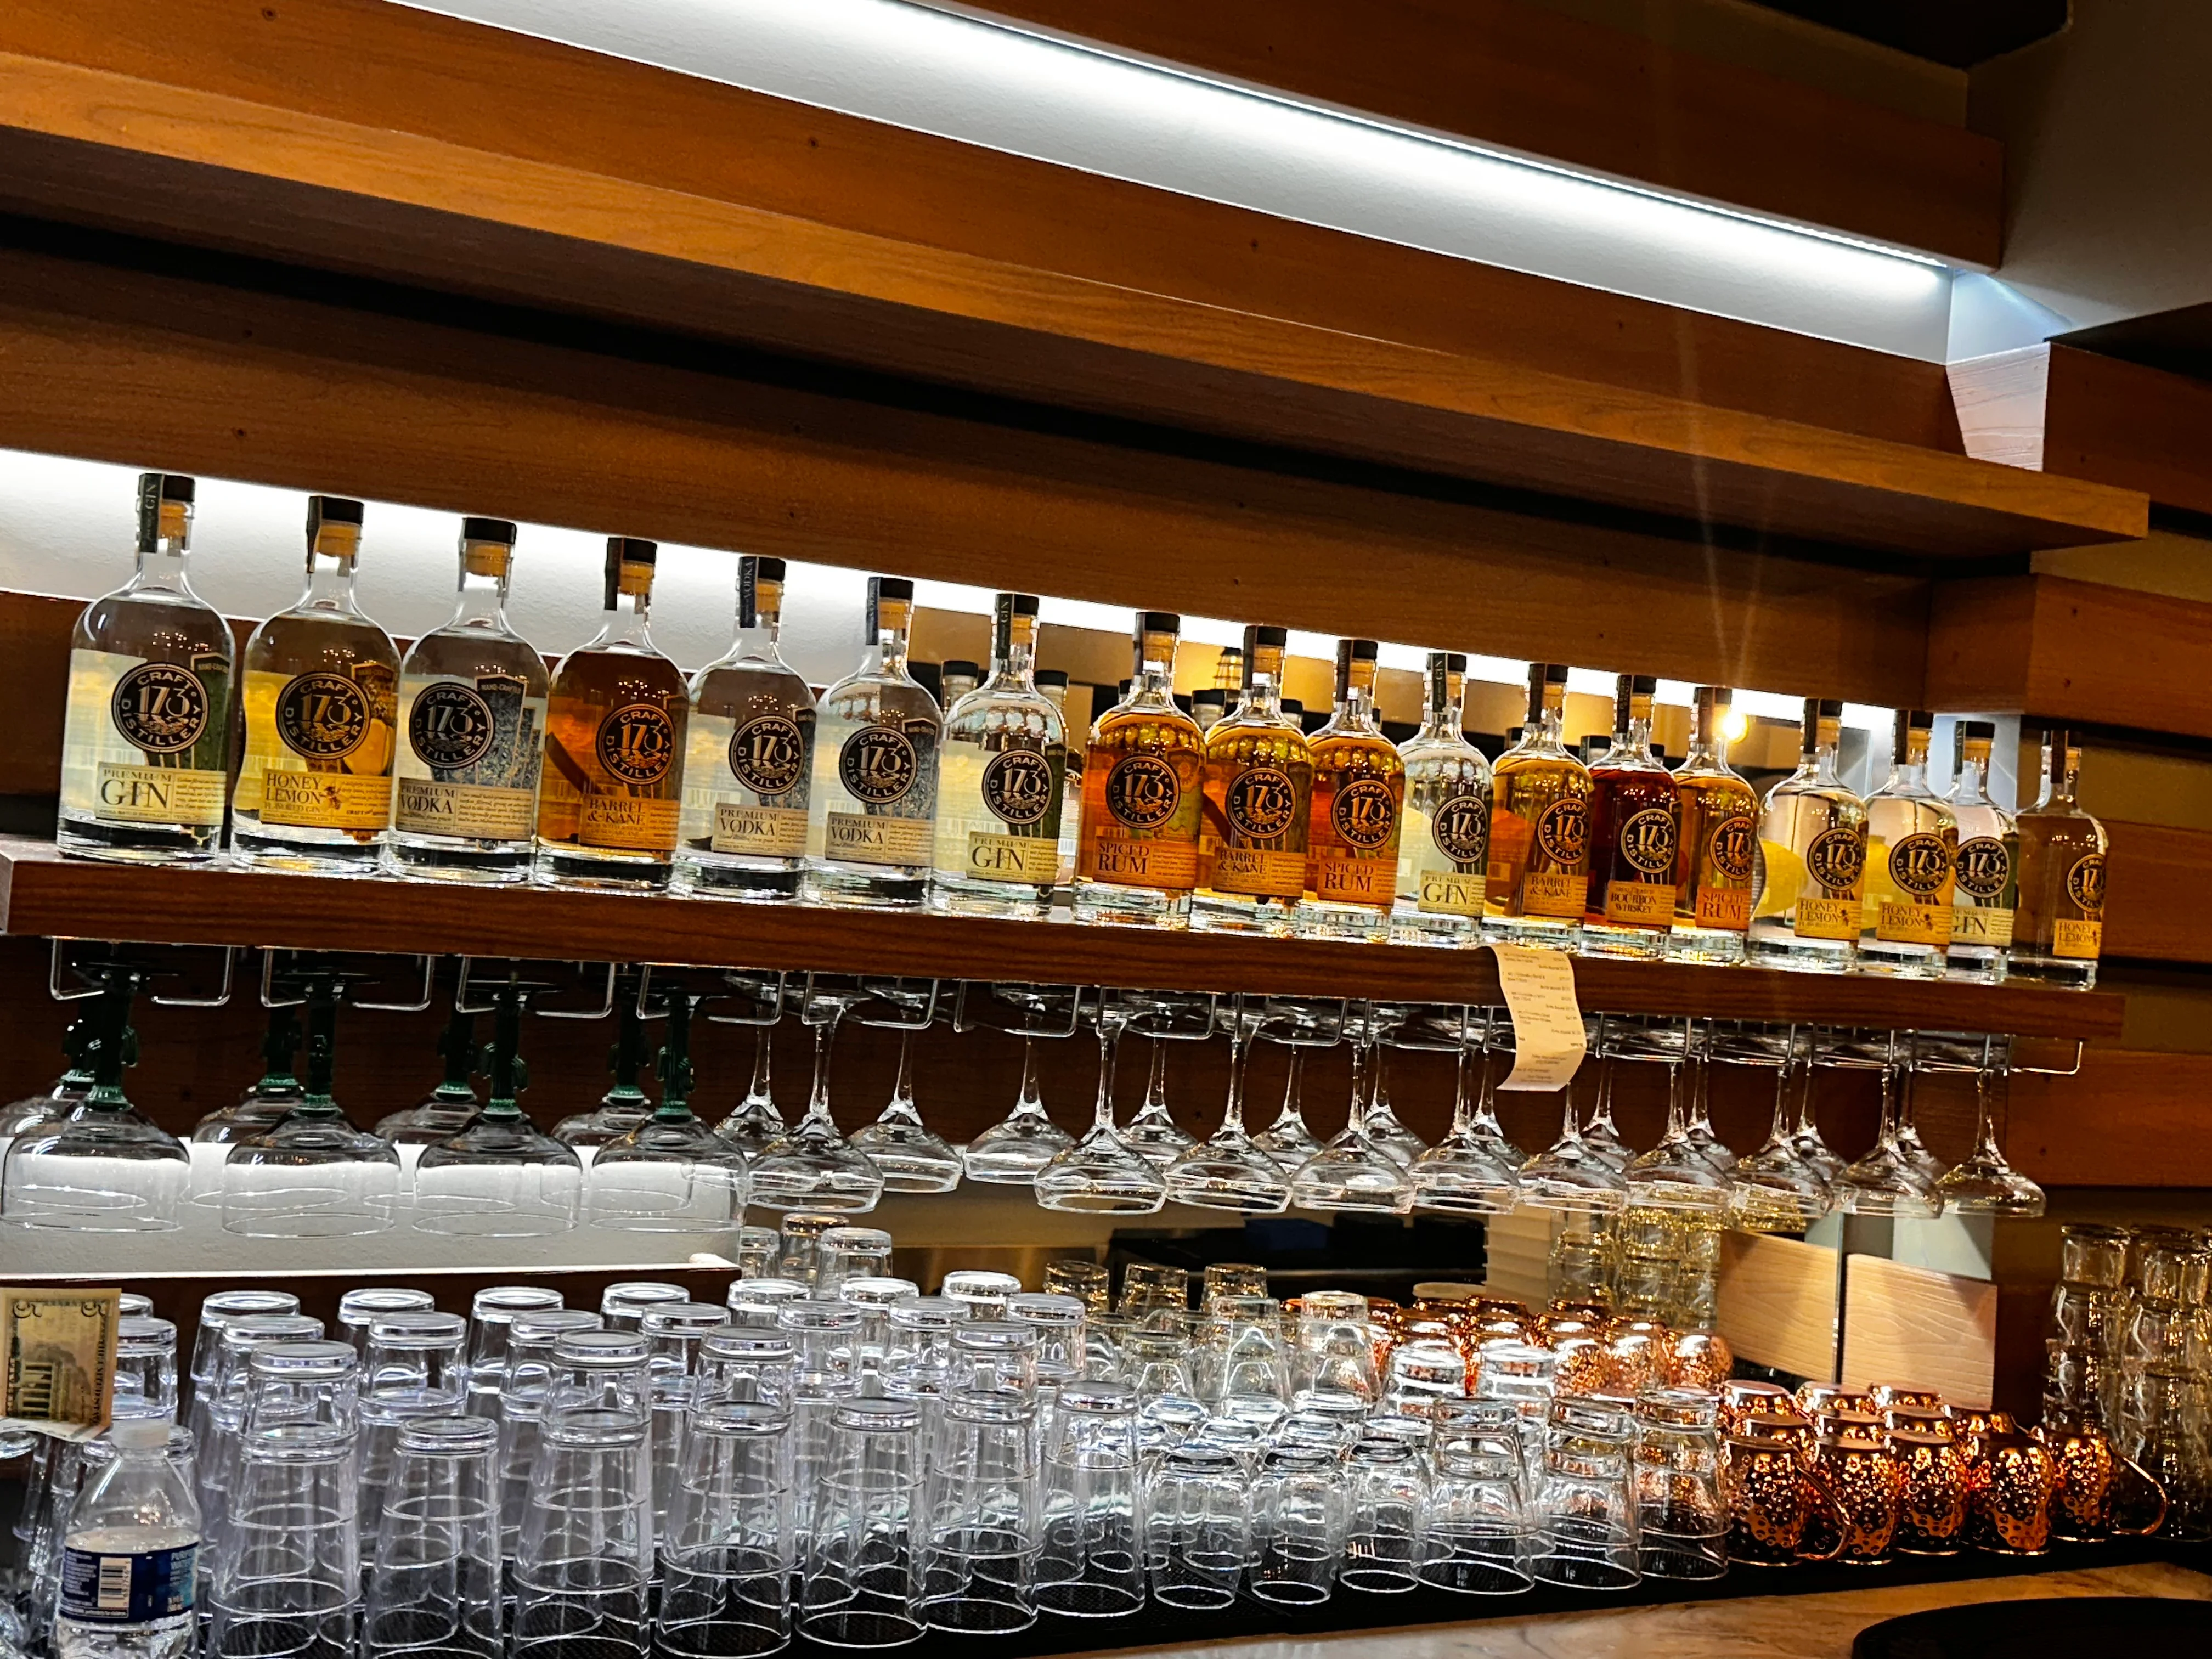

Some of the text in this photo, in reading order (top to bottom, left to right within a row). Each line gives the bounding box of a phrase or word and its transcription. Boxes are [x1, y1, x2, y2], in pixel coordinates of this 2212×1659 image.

[145, 484, 157, 510] GIN
[743, 561, 753, 598] VODKA
[1001, 601, 1009, 623] GIN
[138, 672, 194, 689] CRAFT
[300, 680, 354, 697] CRAFT
[139, 685, 190, 717] 173
[302, 693, 351, 724] 173
[426, 692, 477, 708] CRAFT
[121, 698, 201, 745] DISTILLERY
[428, 705, 473, 735] 173
[620, 710, 664, 727] CRAFT
[285, 707, 363, 752] DISTILLERY
[621, 723, 663, 752] 173
[752, 723, 795, 738] CRAFT
[415, 718, 486, 761] DISTILLERY
[859, 733, 905, 749] CRAFT
[606, 735, 672, 778] DISTILLERY
[753, 735, 792, 763] 173
[738, 746, 800, 788] DISTILLERY
[860, 746, 901, 772] 173
[1003, 757, 1043, 770] CRAFT
[104, 769, 171, 782] PREMIUM
[847, 758, 911, 797] DISTILLERY
[1124, 762, 1167, 777] CRAFT
[267, 772, 323, 790] HONEY
[1003, 768, 1041, 794] 173
[1125, 774, 1164, 799] 173
[1245, 774, 1286, 787] CRAFT
[101, 779, 172, 809] GIN
[266, 788, 321, 804] LEMON
[401, 785, 454, 798] PREMIUM
[990, 779, 1048, 818] DISTILLERY
[1246, 785, 1283, 810] 173
[1351, 786, 1387, 799] CRAFT
[401, 795, 454, 814] VODKA
[589, 799, 645, 813] BARREL
[1113, 784, 1173, 822] DISTILLERY
[1351, 797, 1385, 820] 173
[1451, 802, 1483, 816] CRAFT
[606, 812, 645, 826] KANE
[721, 808, 777, 821] PREMIUM
[1233, 795, 1291, 832] DISTILLERY
[1638, 814, 1671, 829] CRAFT
[721, 818, 775, 836] VODKA
[832, 817, 885, 830] PREMIUM
[1339, 807, 1391, 843] DISTILLERY
[1452, 812, 1481, 836] 173
[1556, 814, 1584, 837] 173
[832, 827, 884, 844] VODKA
[974, 837, 1027, 848] PREMIUM
[1639, 825, 1669, 847] 173
[1727, 832, 1751, 854] 173
[1826, 833, 1857, 846] CRAFT
[1099, 842, 1149, 856] SPICED
[1827, 844, 1855, 866] 173
[1908, 839, 1941, 853] CRAFT
[1968, 843, 2002, 856] CRAFT
[972, 846, 1026, 871] GIN
[1099, 854, 1147, 874] RUM
[1220, 850, 1268, 864] BARREL
[1909, 849, 1940, 871] 173
[1968, 853, 2000, 874] 173
[1232, 862, 1268, 874] KANE
[1325, 861, 1374, 875] SPICED
[1325, 873, 1372, 892] RUM
[1424, 883, 1469, 905] GIN
[1611, 893, 1656, 905] BOURBON
[1703, 893, 1743, 904] SPICED
[1615, 905, 1653, 913] WHISKEY
[1703, 902, 1740, 919] RUM
[1801, 900, 1838, 912] HONEY
[1882, 905, 1921, 916] HONEY
[1799, 911, 1839, 923] LEMON
[1882, 915, 1921, 927] LEMON
